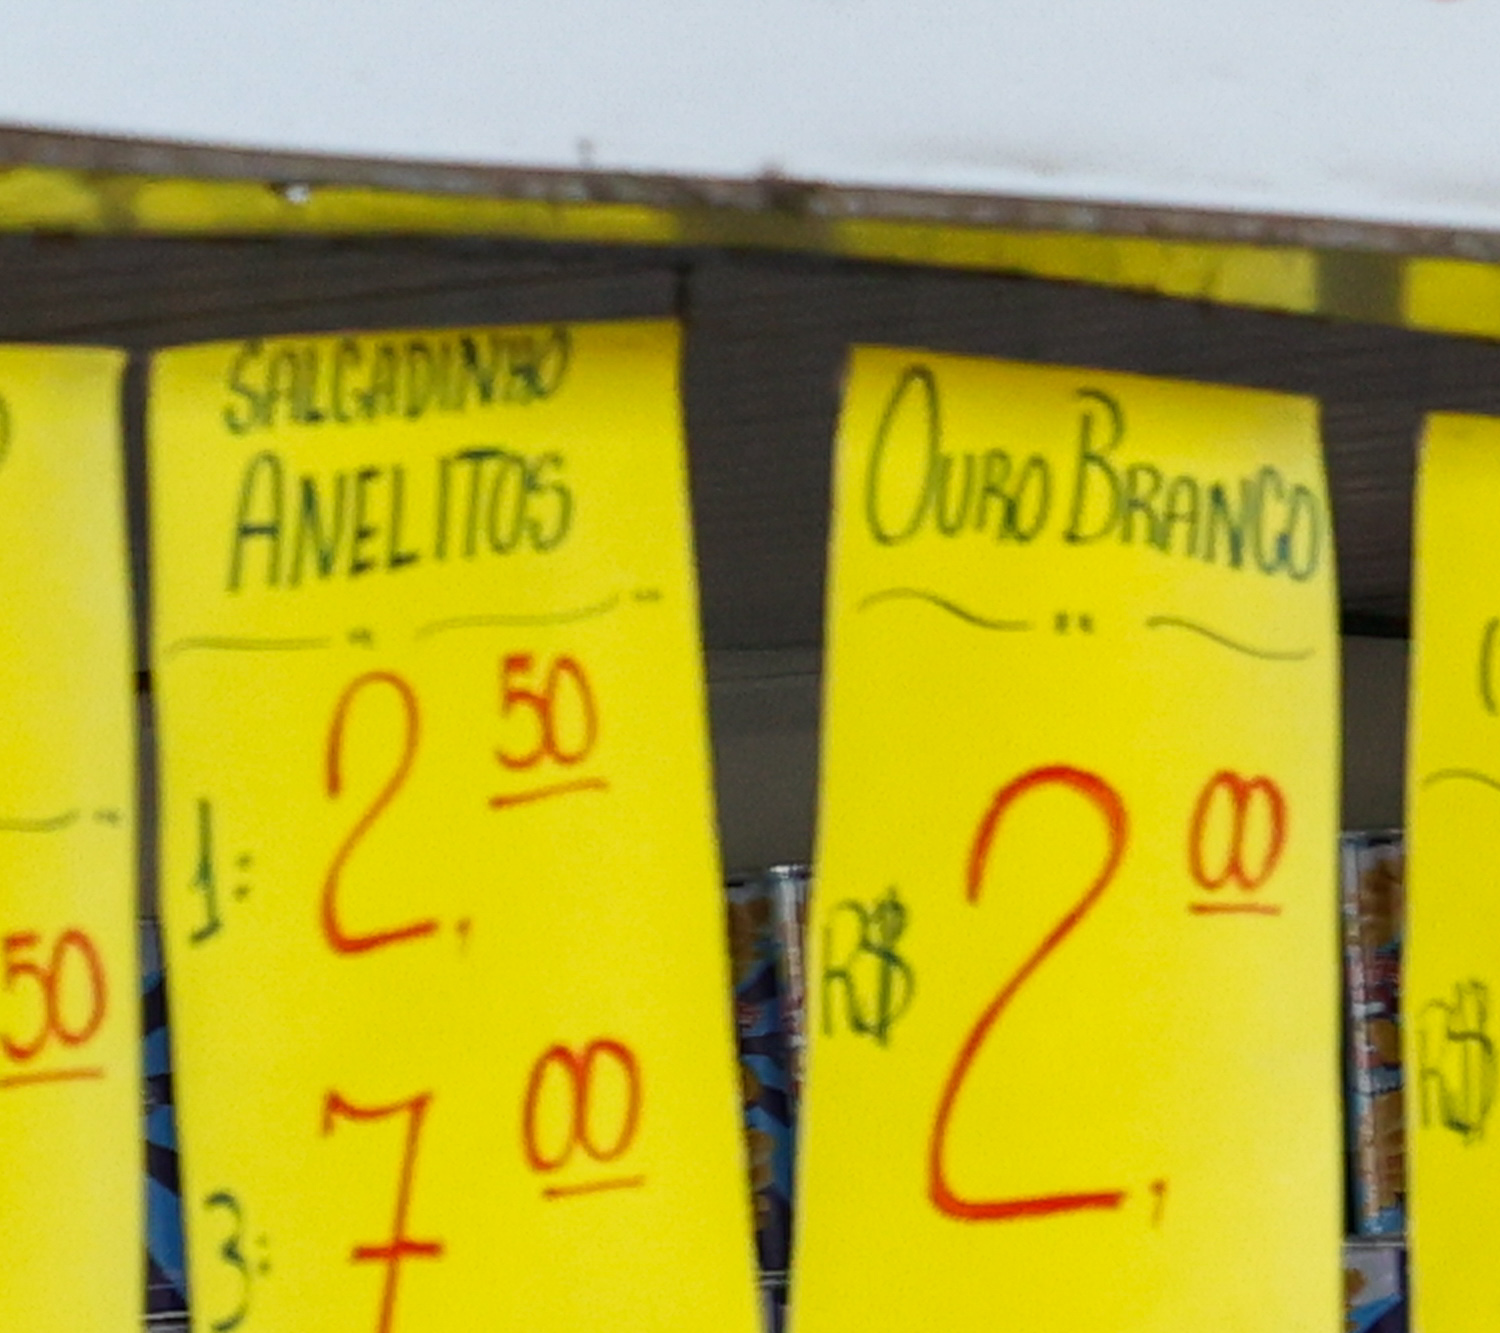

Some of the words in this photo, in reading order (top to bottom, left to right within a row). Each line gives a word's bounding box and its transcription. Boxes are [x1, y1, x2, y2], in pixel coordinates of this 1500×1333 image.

[223, 444, 580, 600] ANELITOS
[865, 360, 1053, 548] OURO
[1062, 384, 1323, 586] BRANCO
[821, 884, 916, 1050] R$
